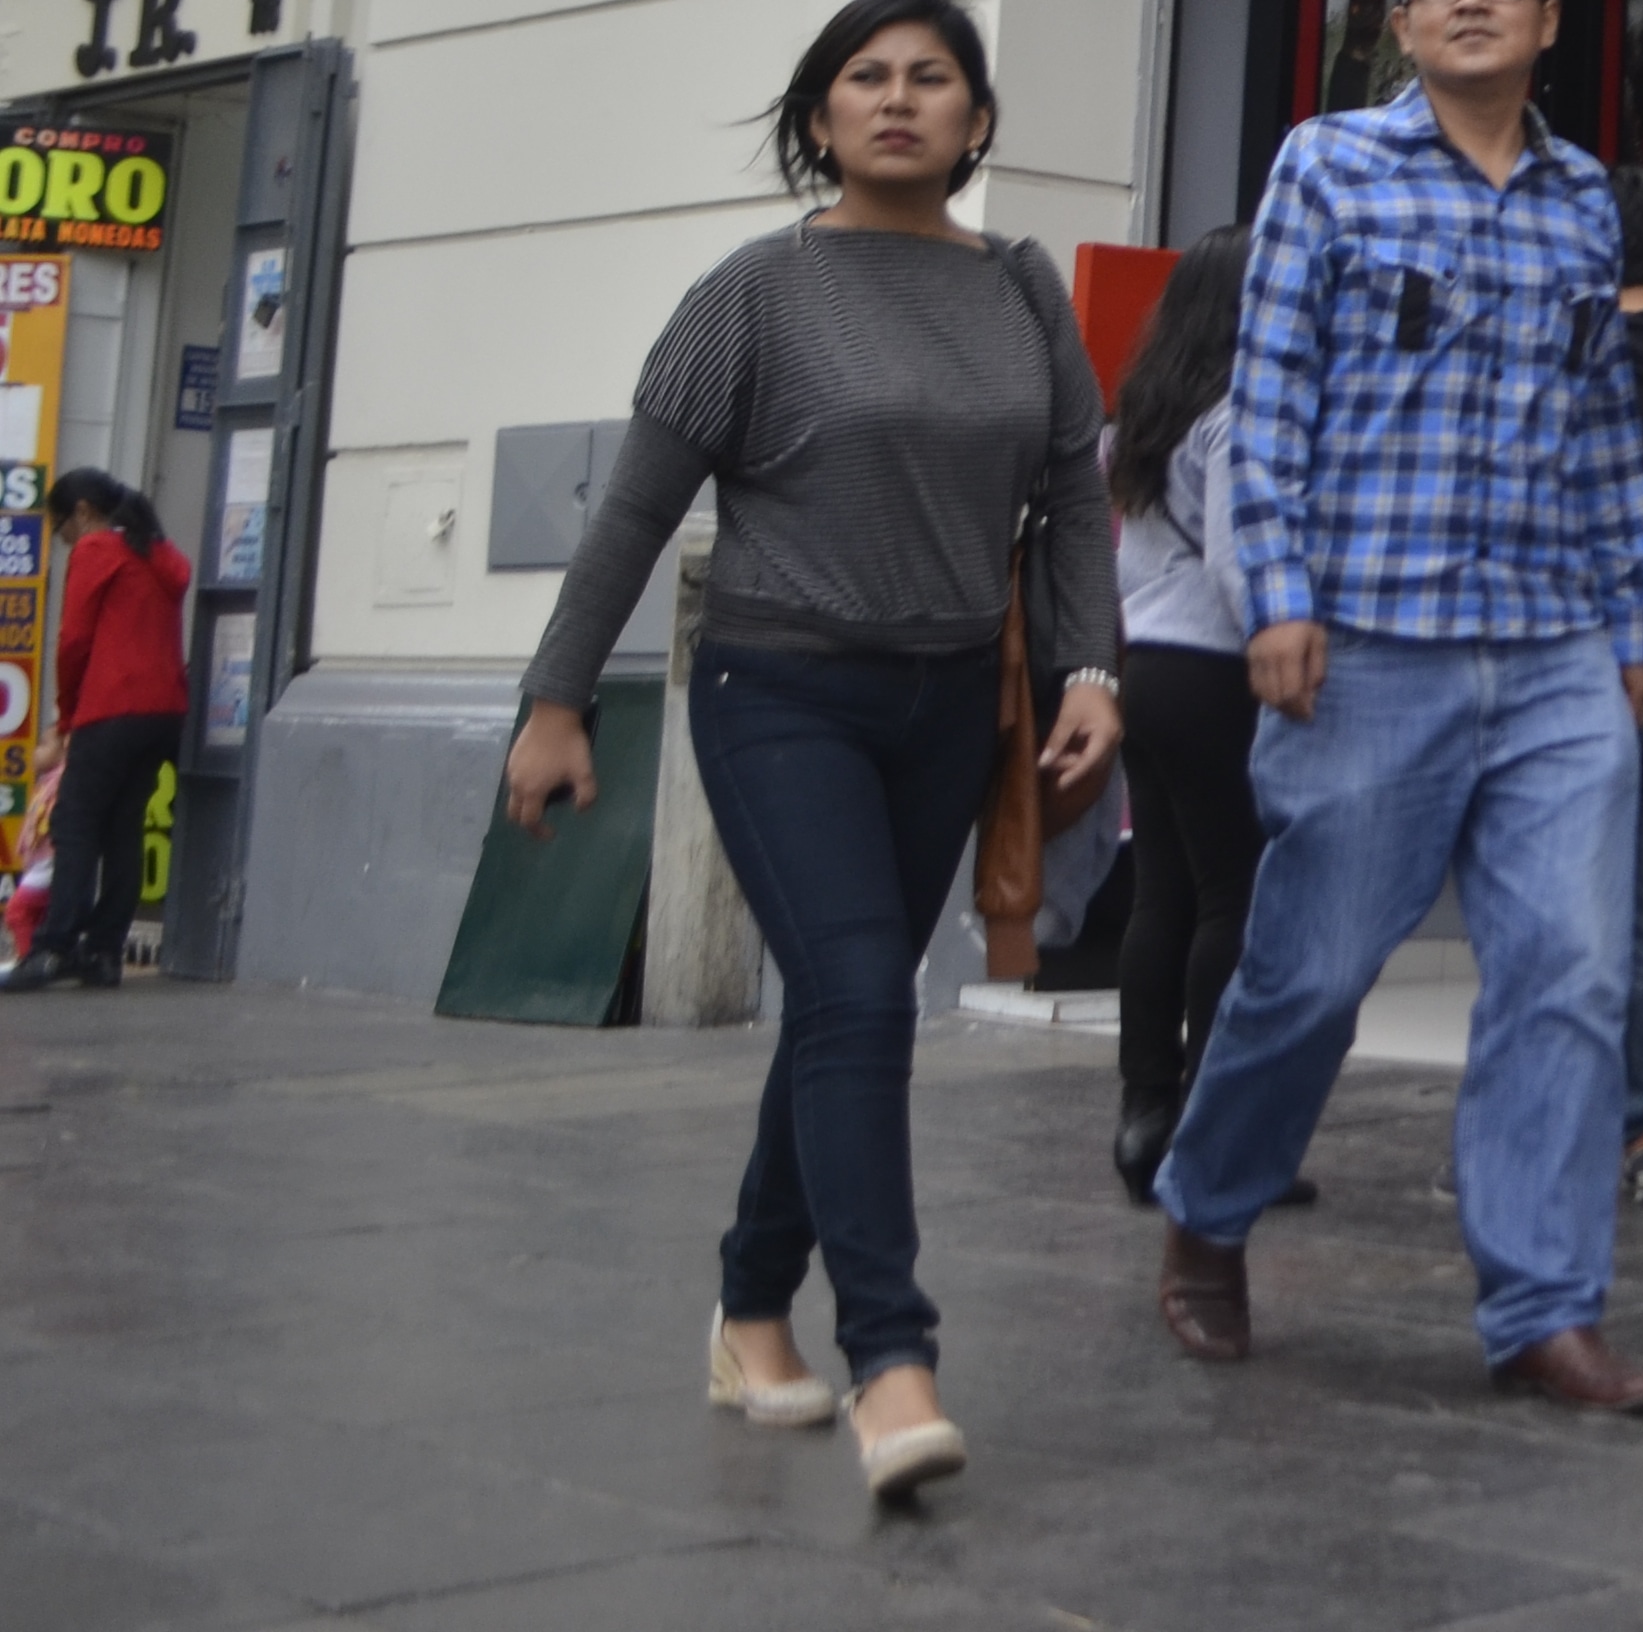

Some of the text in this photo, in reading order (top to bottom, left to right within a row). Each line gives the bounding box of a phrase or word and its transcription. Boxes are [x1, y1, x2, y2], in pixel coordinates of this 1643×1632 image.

[13, 126, 147, 154] COMPRO
[0, 146, 166, 225] ORO
[58, 219, 162, 250] MONEDAS
